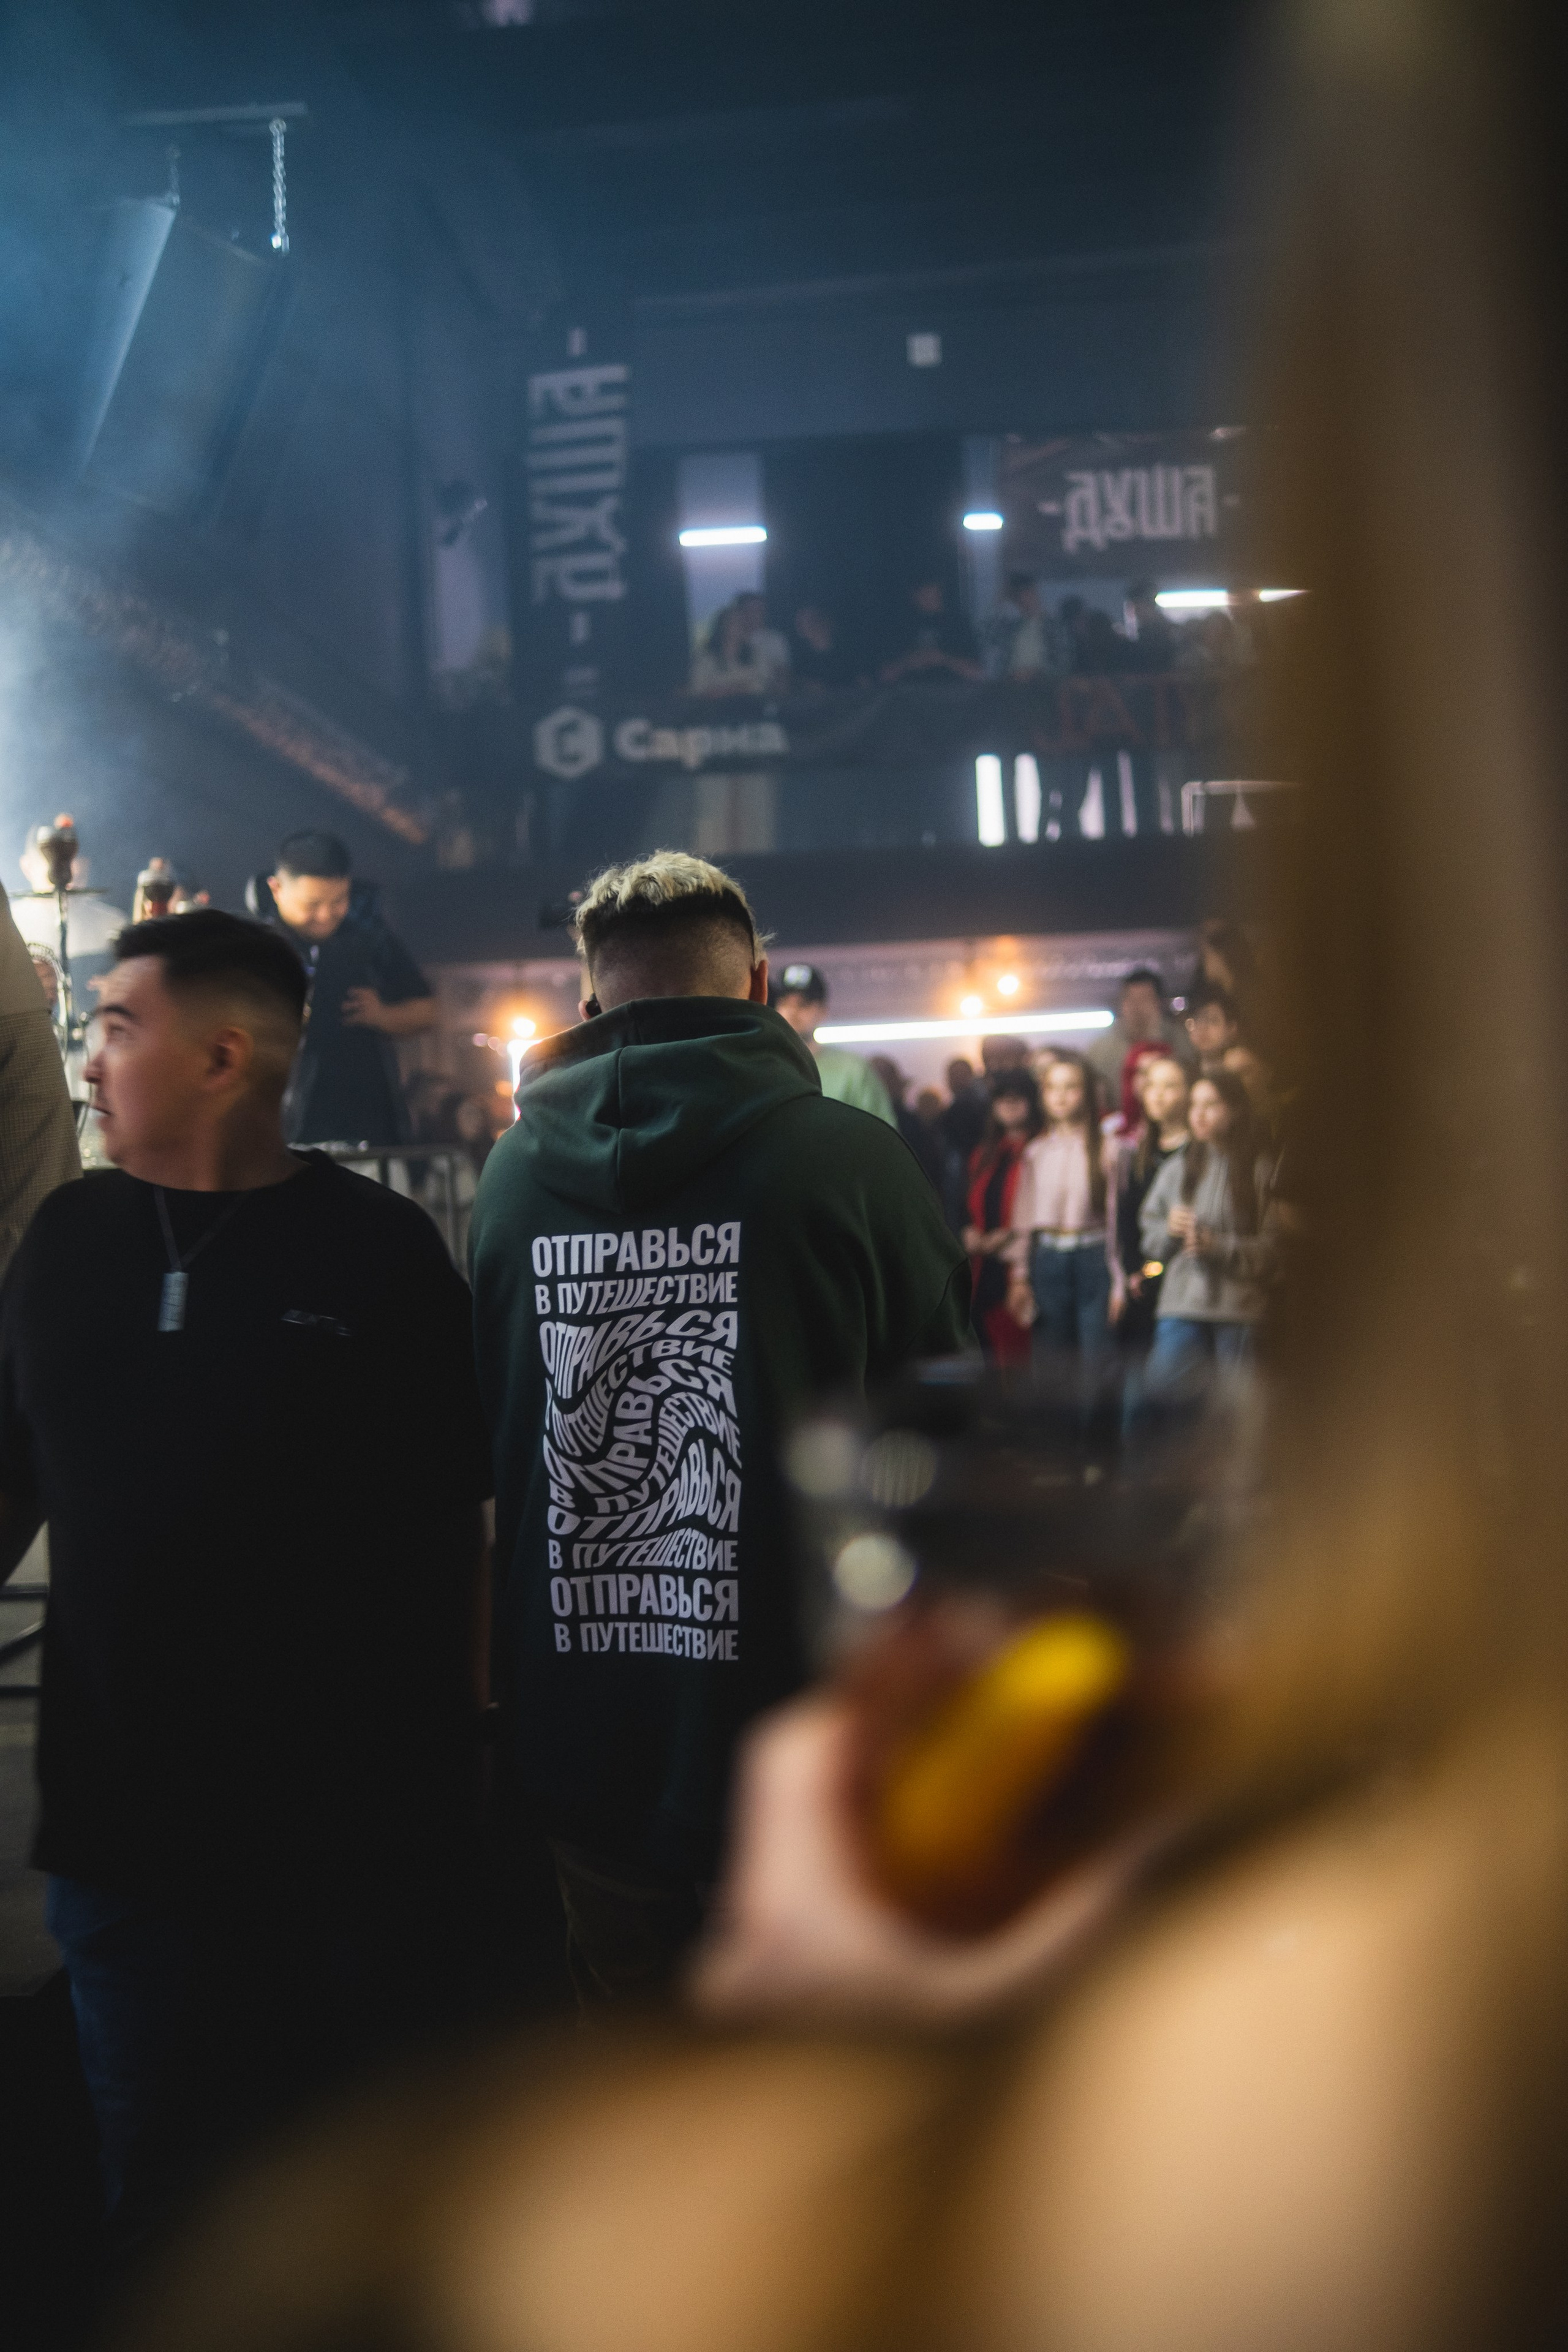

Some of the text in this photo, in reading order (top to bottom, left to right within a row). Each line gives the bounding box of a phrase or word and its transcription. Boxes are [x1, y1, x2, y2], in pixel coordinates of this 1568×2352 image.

[532, 1221, 741, 1278] ОТПРАВЬСЯ
[535, 1272, 738, 1315] В ПУТЕШЕСТВИЕ
[539, 1310, 737, 1399] ОТПРАВЬСЯ
[543, 1359, 737, 1494] ОТПРАВЬСЯ
[552, 1339, 735, 1457] ПУТЕШЕСТВИЕ
[547, 1438, 742, 1539] ОТПРАВЬСЯ
[594, 1391, 742, 1515] ПУТЕШЕСТВИЕ
[549, 1528, 739, 1572] В ПУТЕШЕСТВИЕ
[550, 1573, 739, 1622] ОТПРАВЬСЯ
[554, 1622, 739, 1661] В ПУТЕШЕСТВИЕ
